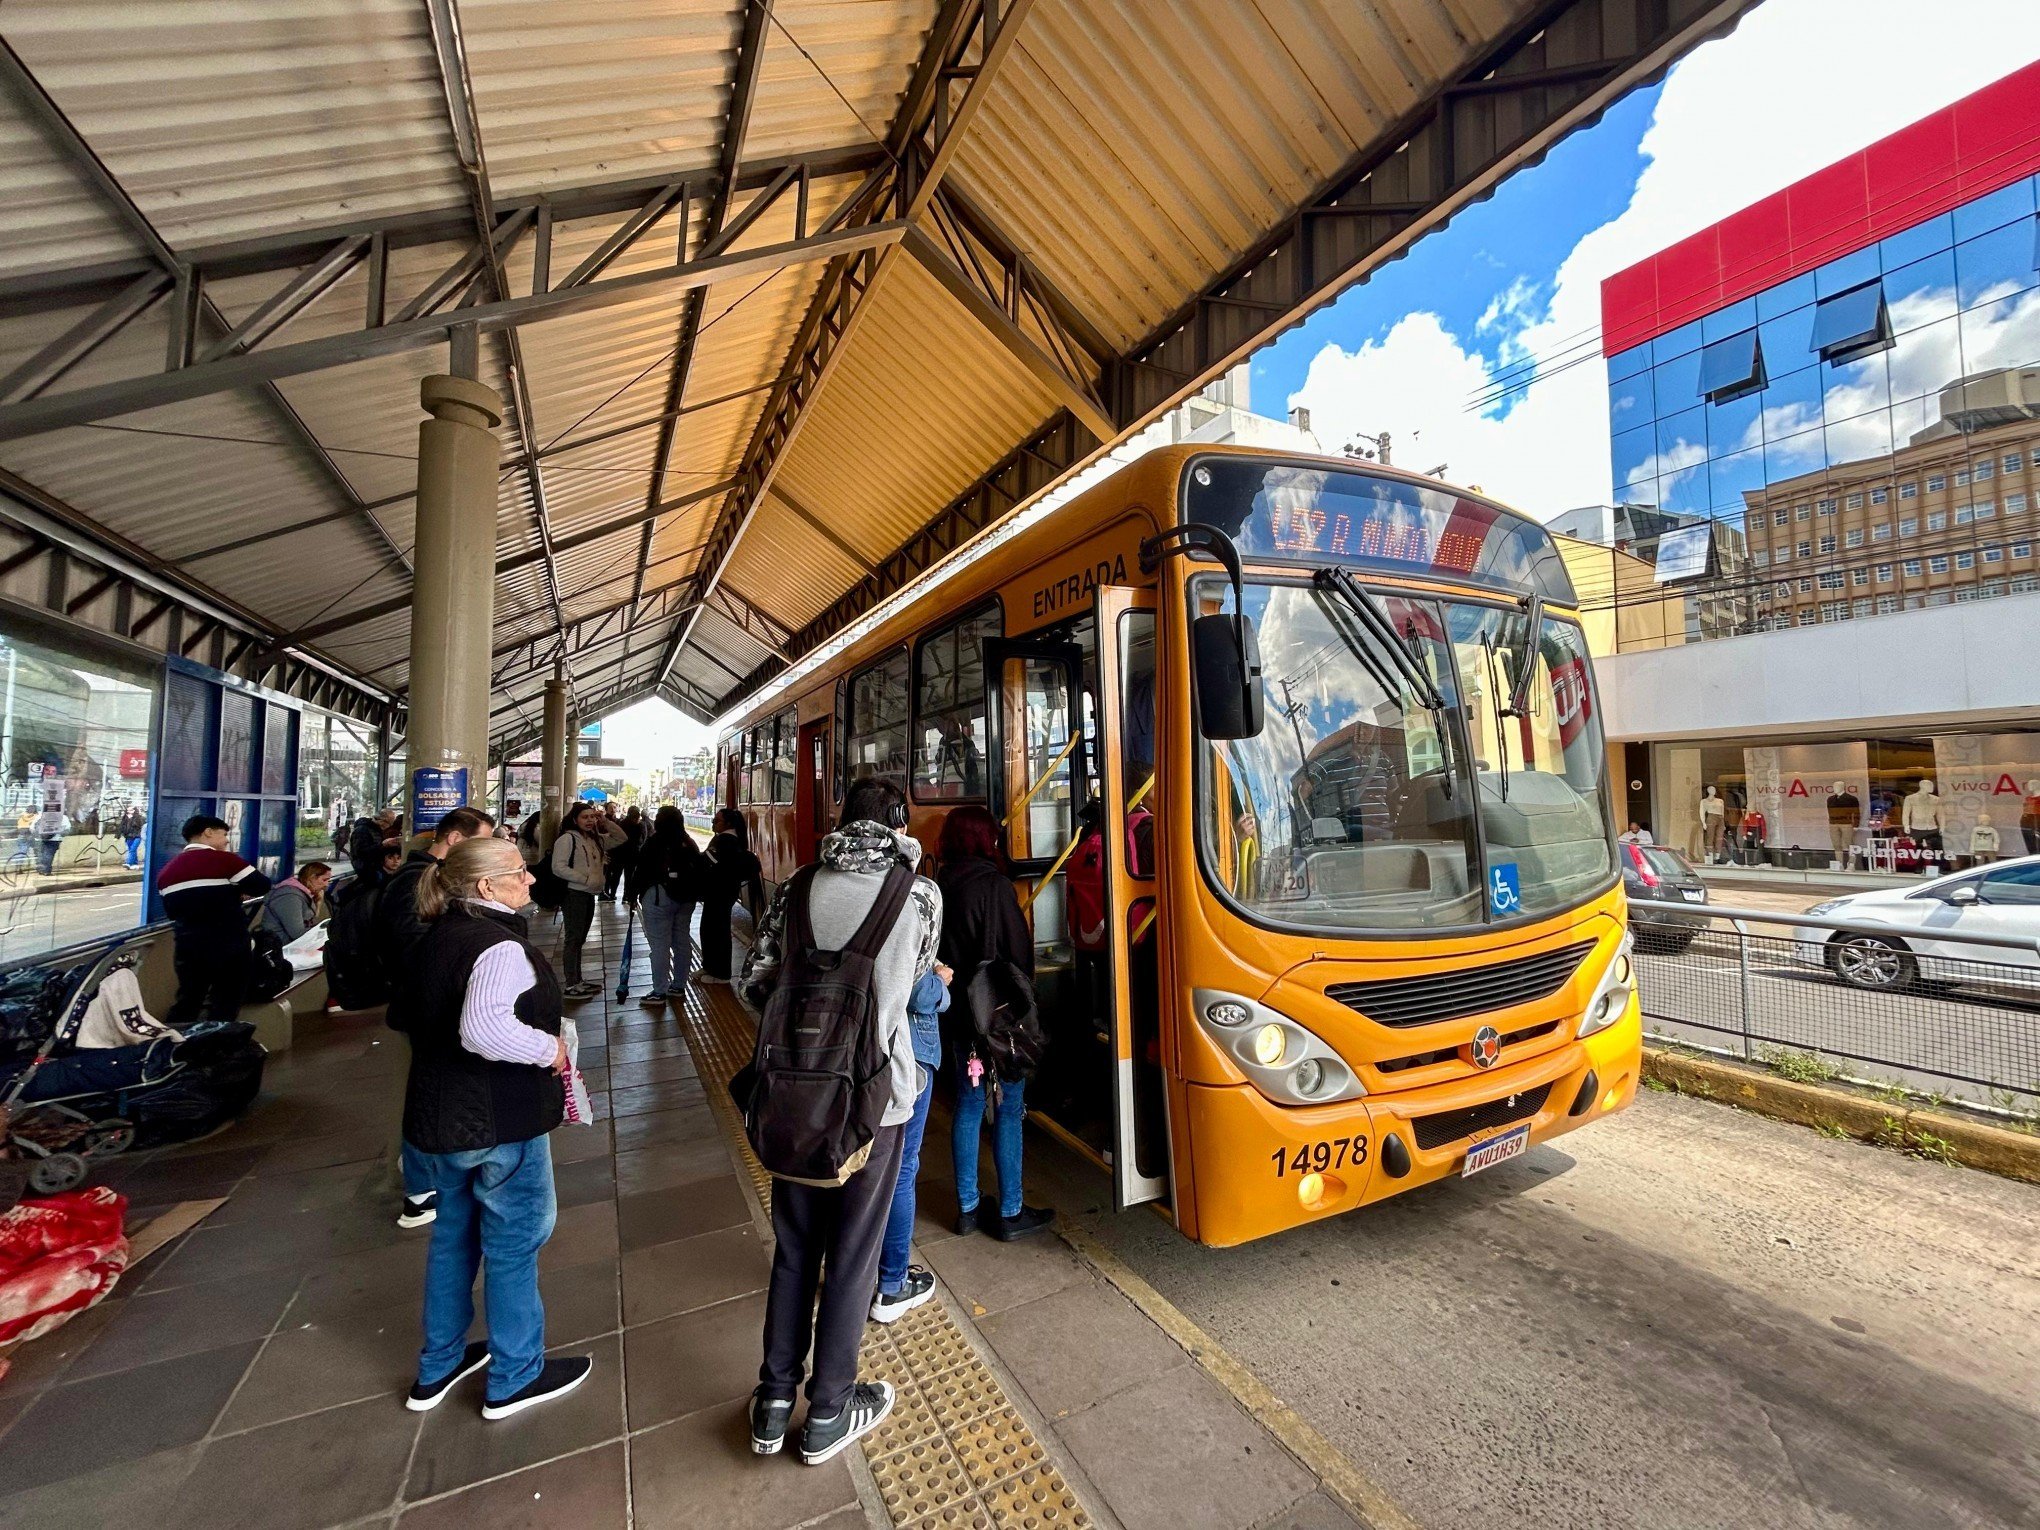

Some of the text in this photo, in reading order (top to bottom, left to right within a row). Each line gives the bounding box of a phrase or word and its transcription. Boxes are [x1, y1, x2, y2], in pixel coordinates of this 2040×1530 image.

[1034, 554, 1127, 618] ENTRADA
[1271, 1135, 1368, 1178] 14978
[1469, 1136, 1523, 1172] AWU1H39
